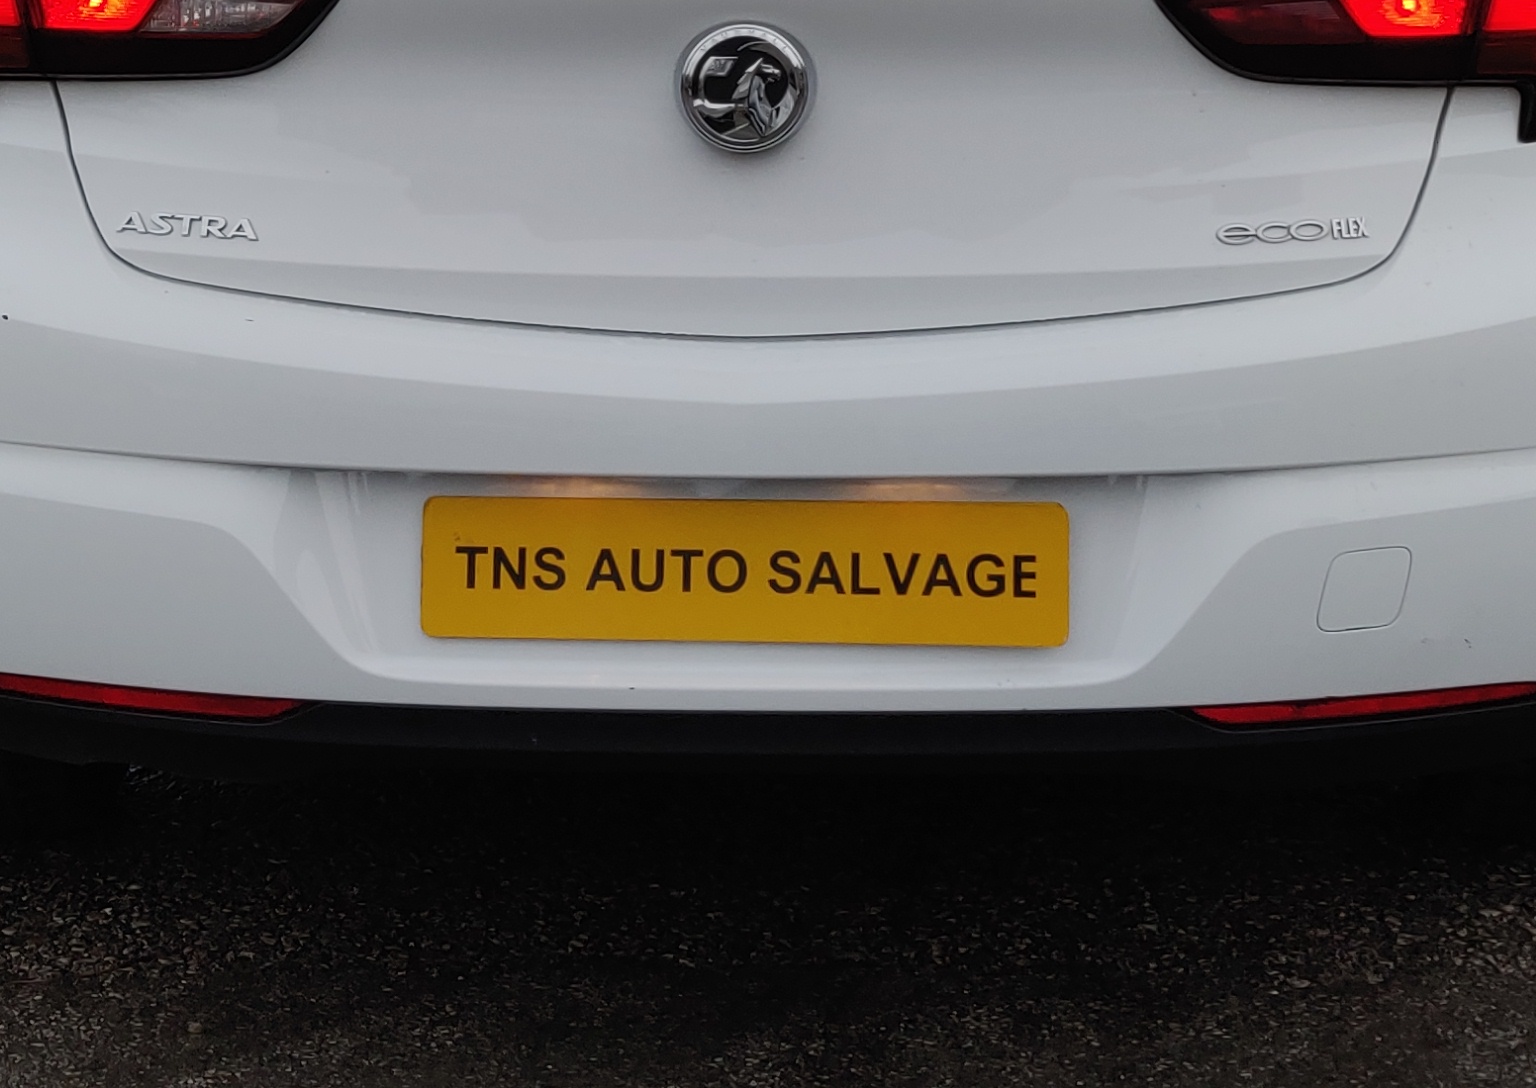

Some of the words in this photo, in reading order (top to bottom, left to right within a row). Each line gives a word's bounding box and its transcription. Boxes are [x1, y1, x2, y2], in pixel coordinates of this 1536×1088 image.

[116, 211, 260, 242] ASTRA
[455, 546, 566, 591] TNS
[585, 548, 748, 594] AUTO
[767, 550, 1037, 599] SALVAGE
